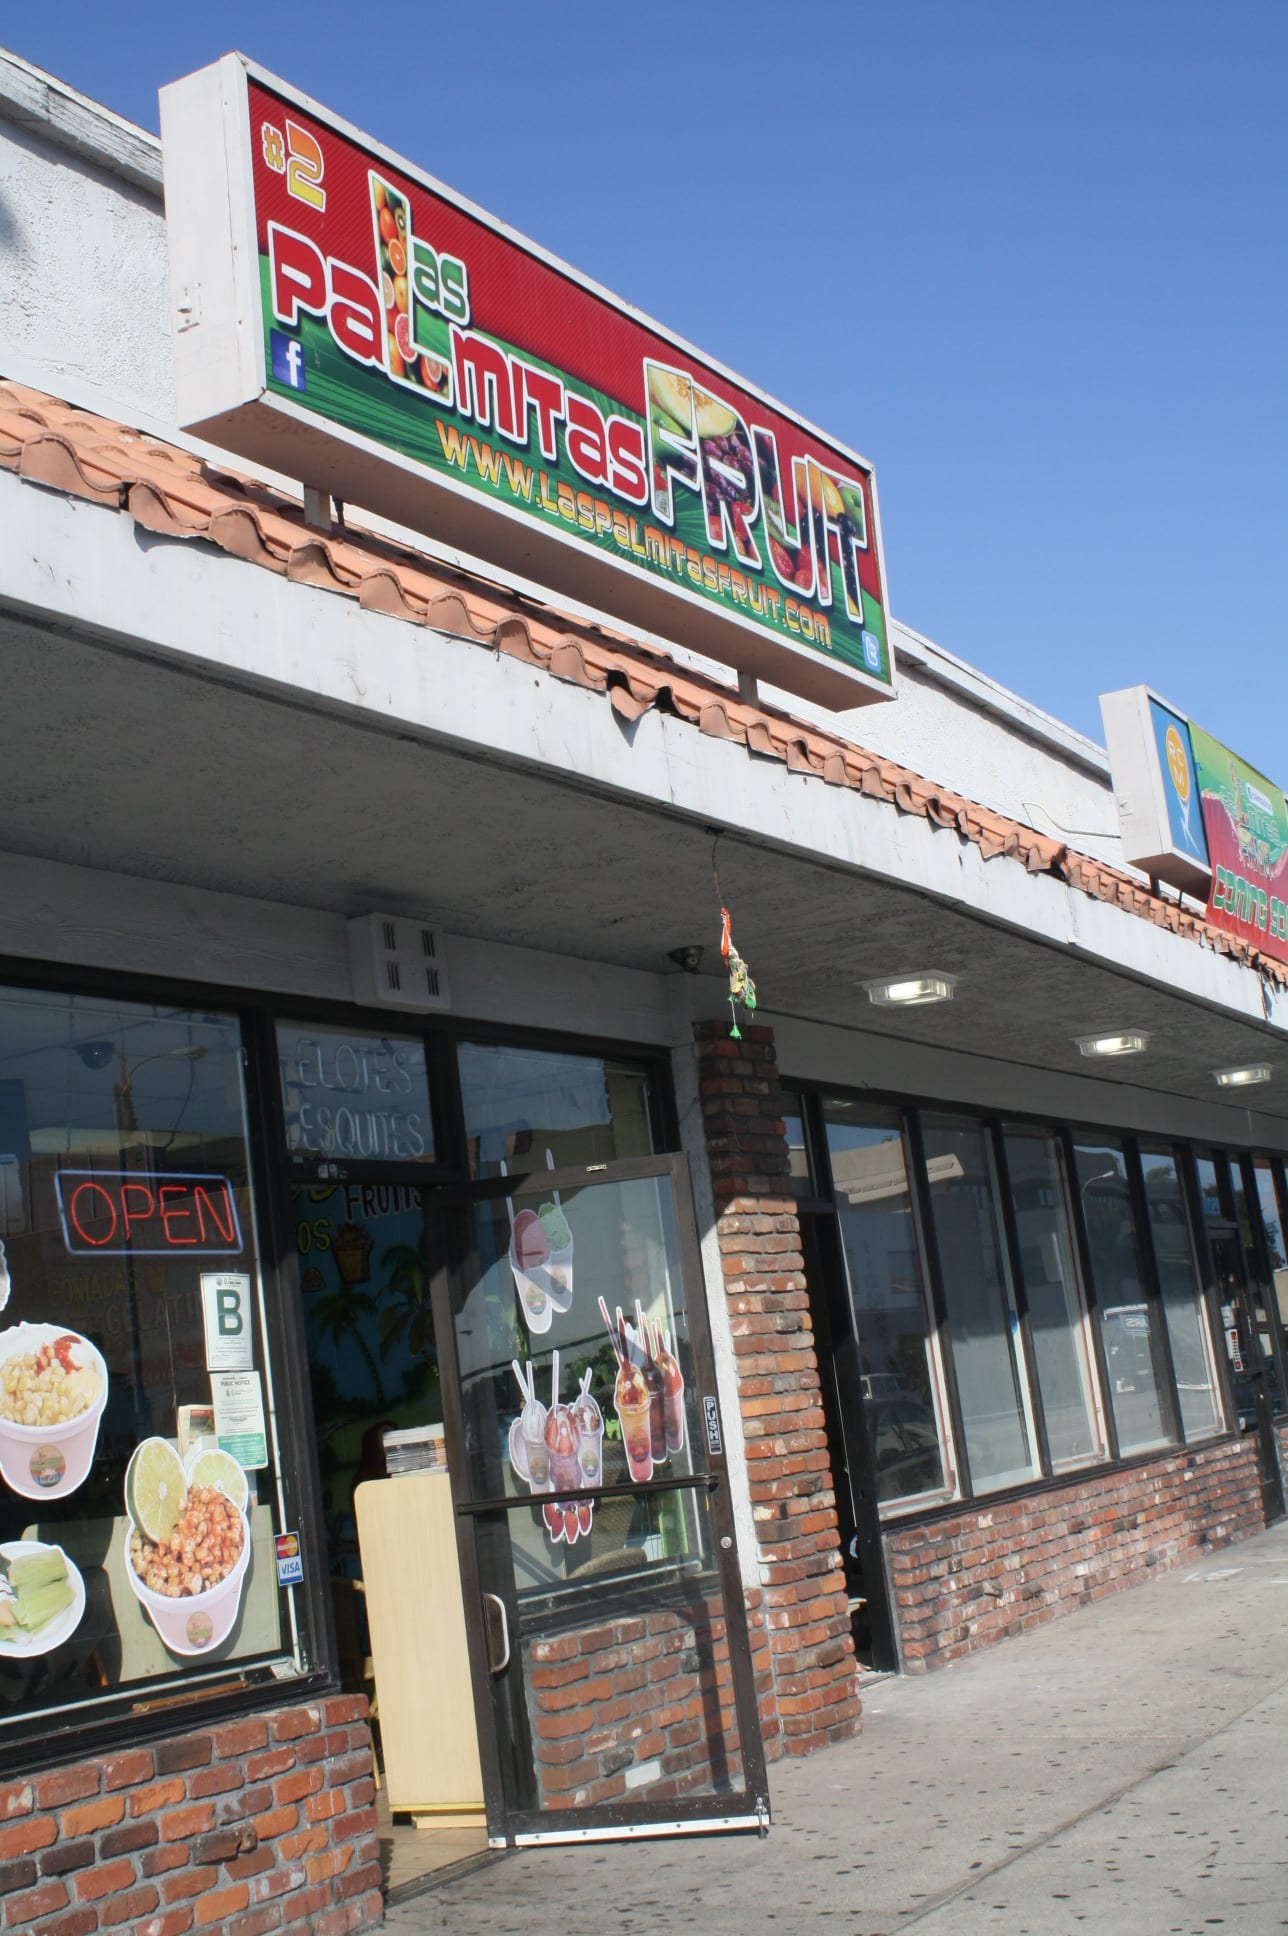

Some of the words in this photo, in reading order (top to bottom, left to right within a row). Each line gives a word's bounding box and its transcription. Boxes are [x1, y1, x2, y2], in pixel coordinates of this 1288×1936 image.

[261, 119, 326, 213] #2
[643, 357, 868, 624] FRUIT
[1212, 864, 1267, 932] COMING
[296, 1039, 415, 1096] ELOTES
[299, 1103, 426, 1158] ESQUITES
[71, 1183, 234, 1246] OPEN
[216, 1289, 244, 1336] B
[706, 1401, 719, 1440] PUSH
[281, 1561, 300, 1575] VISA
